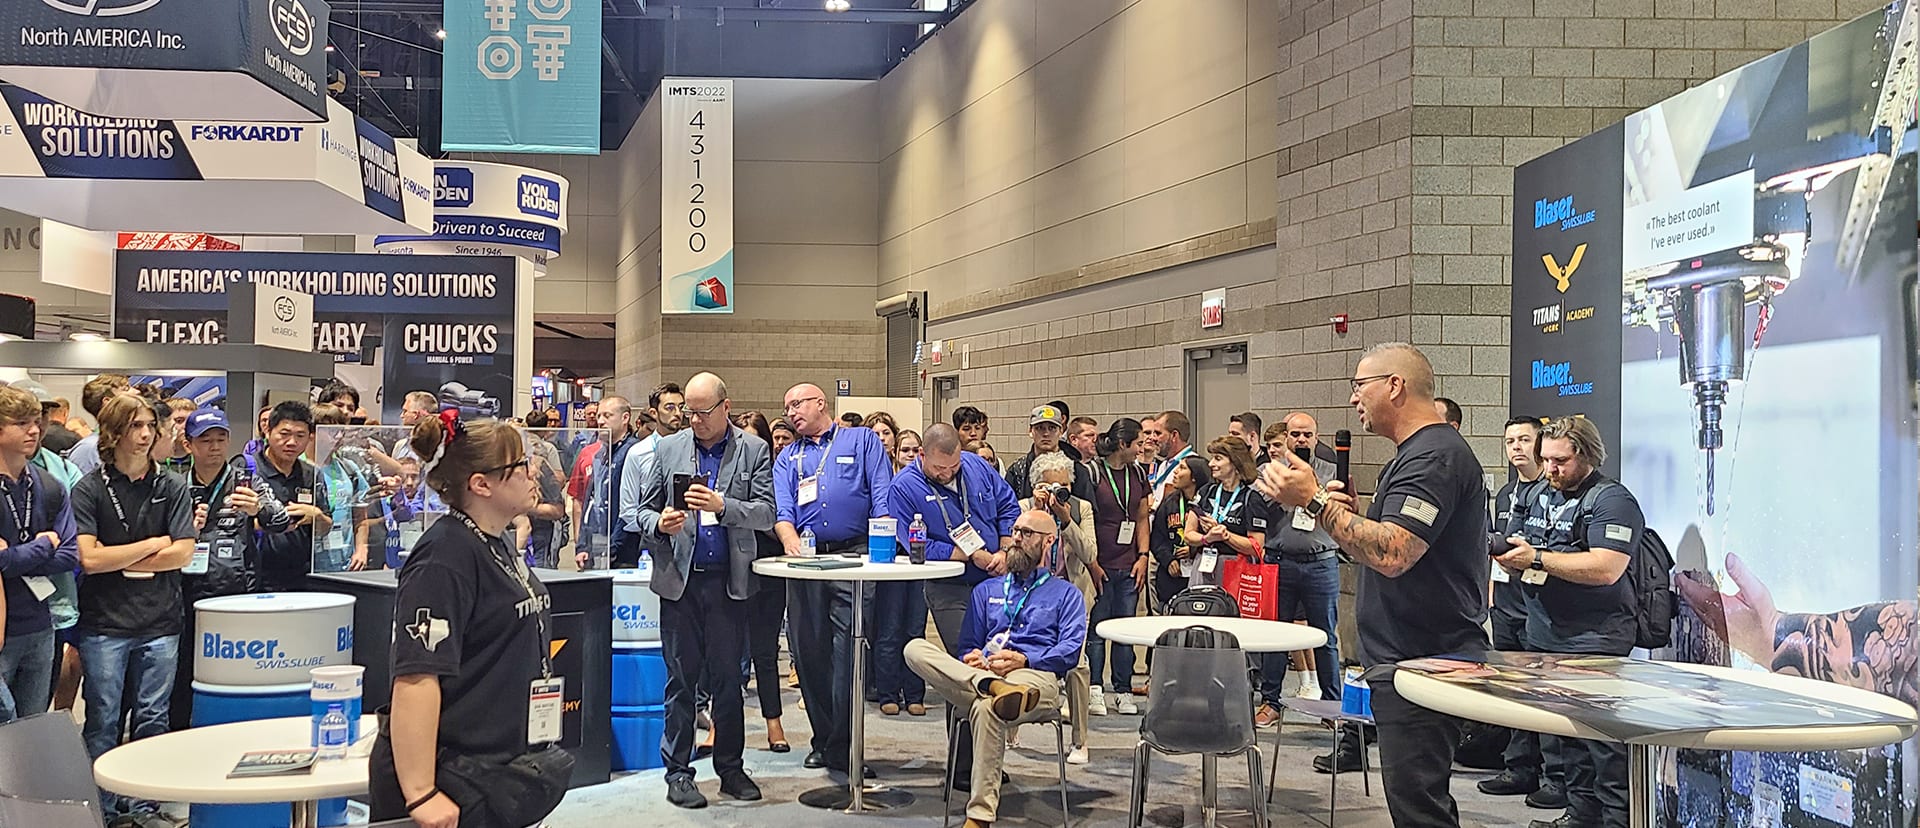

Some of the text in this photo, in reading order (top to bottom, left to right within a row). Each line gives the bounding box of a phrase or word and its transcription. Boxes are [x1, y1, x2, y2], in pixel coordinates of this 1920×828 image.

[278, 6, 306, 41] FCS
[21, 28, 186, 49] North AMERICA Inc.
[264, 47, 318, 96] North AMERICA Inc.
[669, 87, 726, 96] IMTS2022
[41, 127, 174, 159] SOLUTIONS
[191, 125, 304, 142] FORKARDT
[330, 139, 358, 162] HARDINGE
[359, 135, 397, 174] WORKHOLDING
[363, 160, 401, 202] SOLUTIONS
[521, 181, 549, 198] VON
[521, 195, 559, 215] RUDEN
[1534, 195, 1576, 229] Blaser.
[1667, 212, 1685, 225] best
[1687, 200, 1720, 220] coolant
[1561, 209, 1596, 231] SWISSLUBE
[480, 222, 495, 235] to
[497, 224, 545, 242] Succeed
[1667, 232, 1685, 246] ever
[455, 245, 479, 254] Since
[392, 274, 497, 298] SOLUTIONS
[278, 304, 292, 315] FCS
[1203, 305, 1220, 325] STAIRS
[1533, 304, 1559, 326] TITANS
[1566, 307, 1594, 321] ACADEMY
[404, 323, 498, 353] CHUCKS
[454, 356, 473, 364] POWER
[1532, 359, 1573, 389] Blaser.
[1558, 382, 1593, 396] SWISSLUBE
[1555, 522, 1573, 531] CNC
[203, 632, 285, 660] Blaser.
[255, 656, 325, 669] SWISSLUBE
